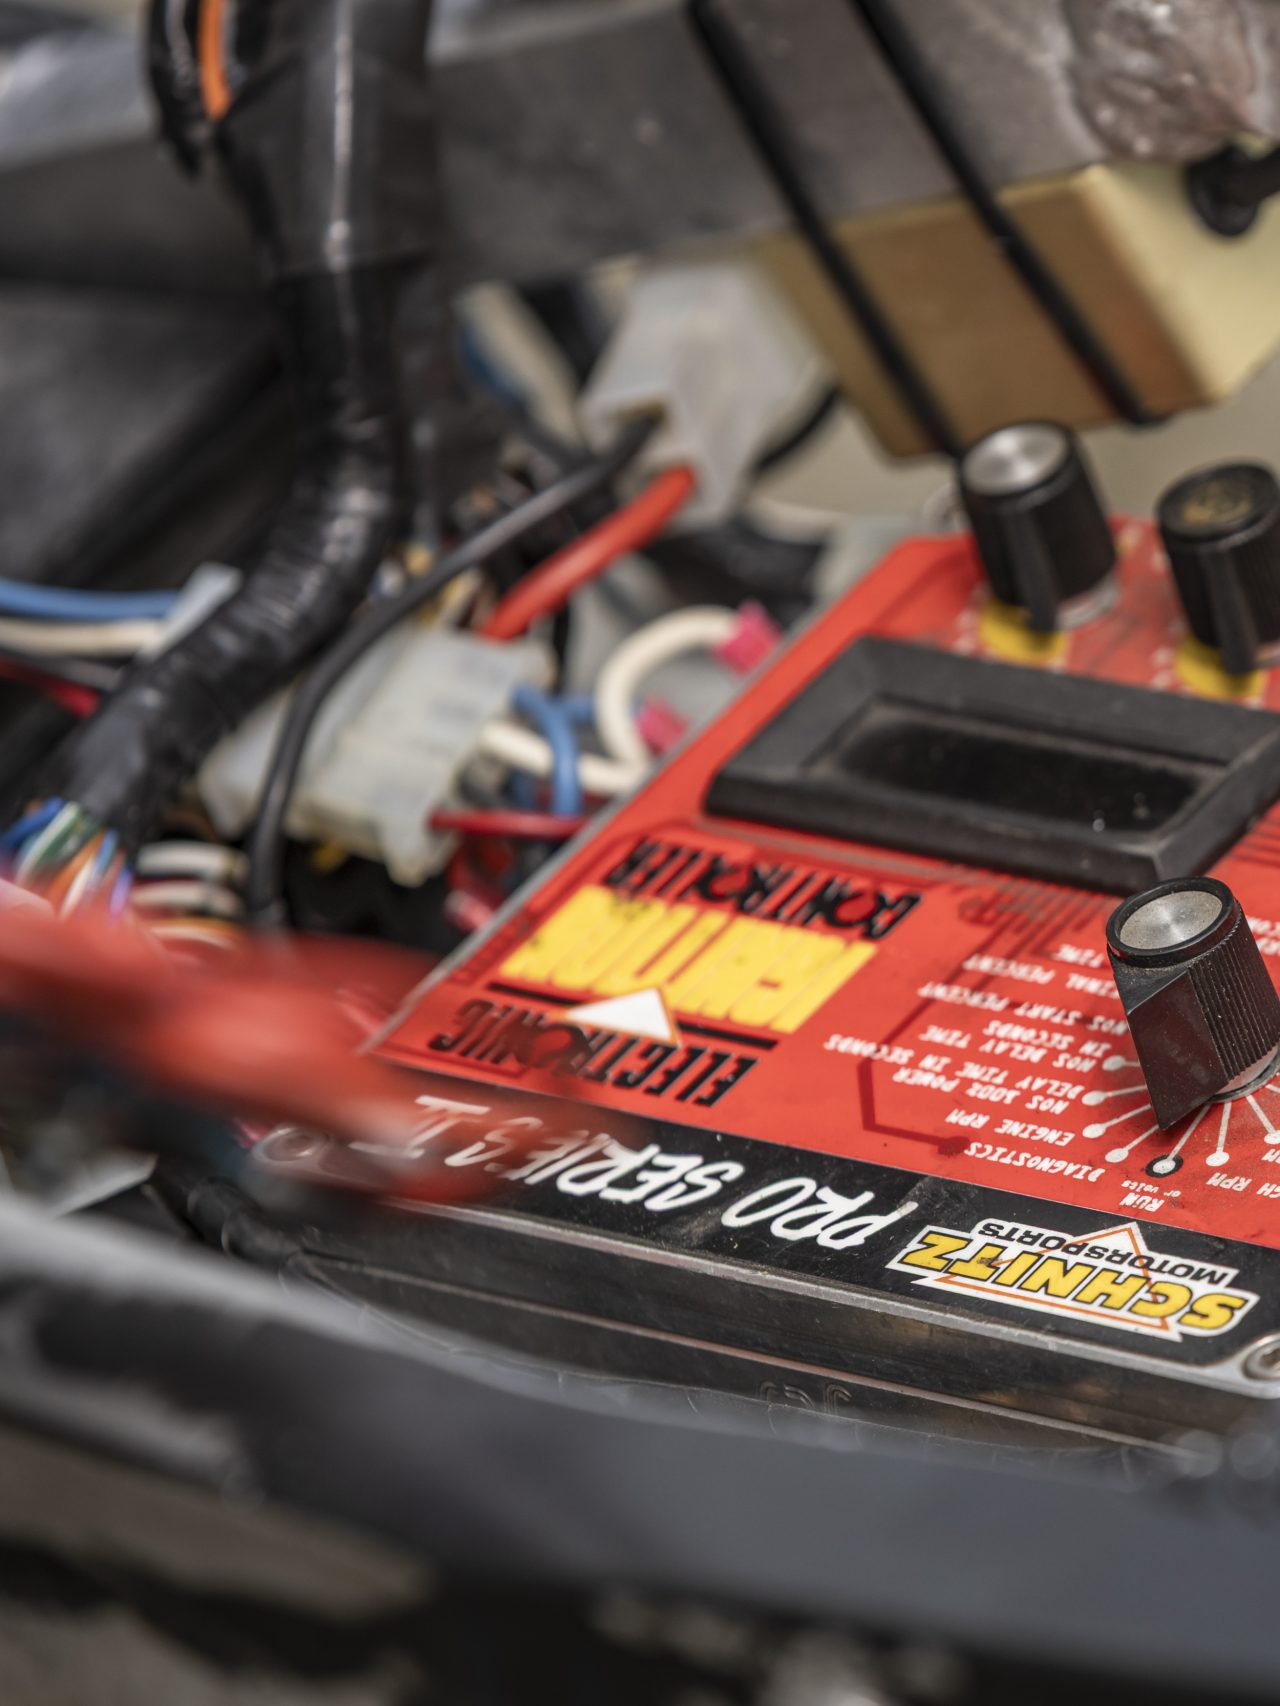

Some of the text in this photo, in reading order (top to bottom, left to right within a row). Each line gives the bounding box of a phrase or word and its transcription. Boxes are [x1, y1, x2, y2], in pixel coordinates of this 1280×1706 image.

[917, 982, 1128, 1035] NOS START PERCENT
[918, 1025, 1097, 1072] NOS DELAY TIME
[982, 1020, 1112, 1057] IN SECONDS
[822, 1033, 1084, 1099] DELAY TIME IN SECONDS
[892, 1067, 960, 1093] POWER
[1025, 1095, 1069, 1115] NOS
[945, 1109, 1075, 1147] ENGINE RPM
[964, 1140, 1105, 1182] DIAGNOSTICS
[1205, 1173, 1250, 1191] RPM
[722, 1177, 918, 1249] PRO
[1120, 1192, 1164, 1212] RUN
[978, 1220, 1230, 1285] MOTORSPORTS
[895, 1232, 1248, 1331] SCHNITZ
